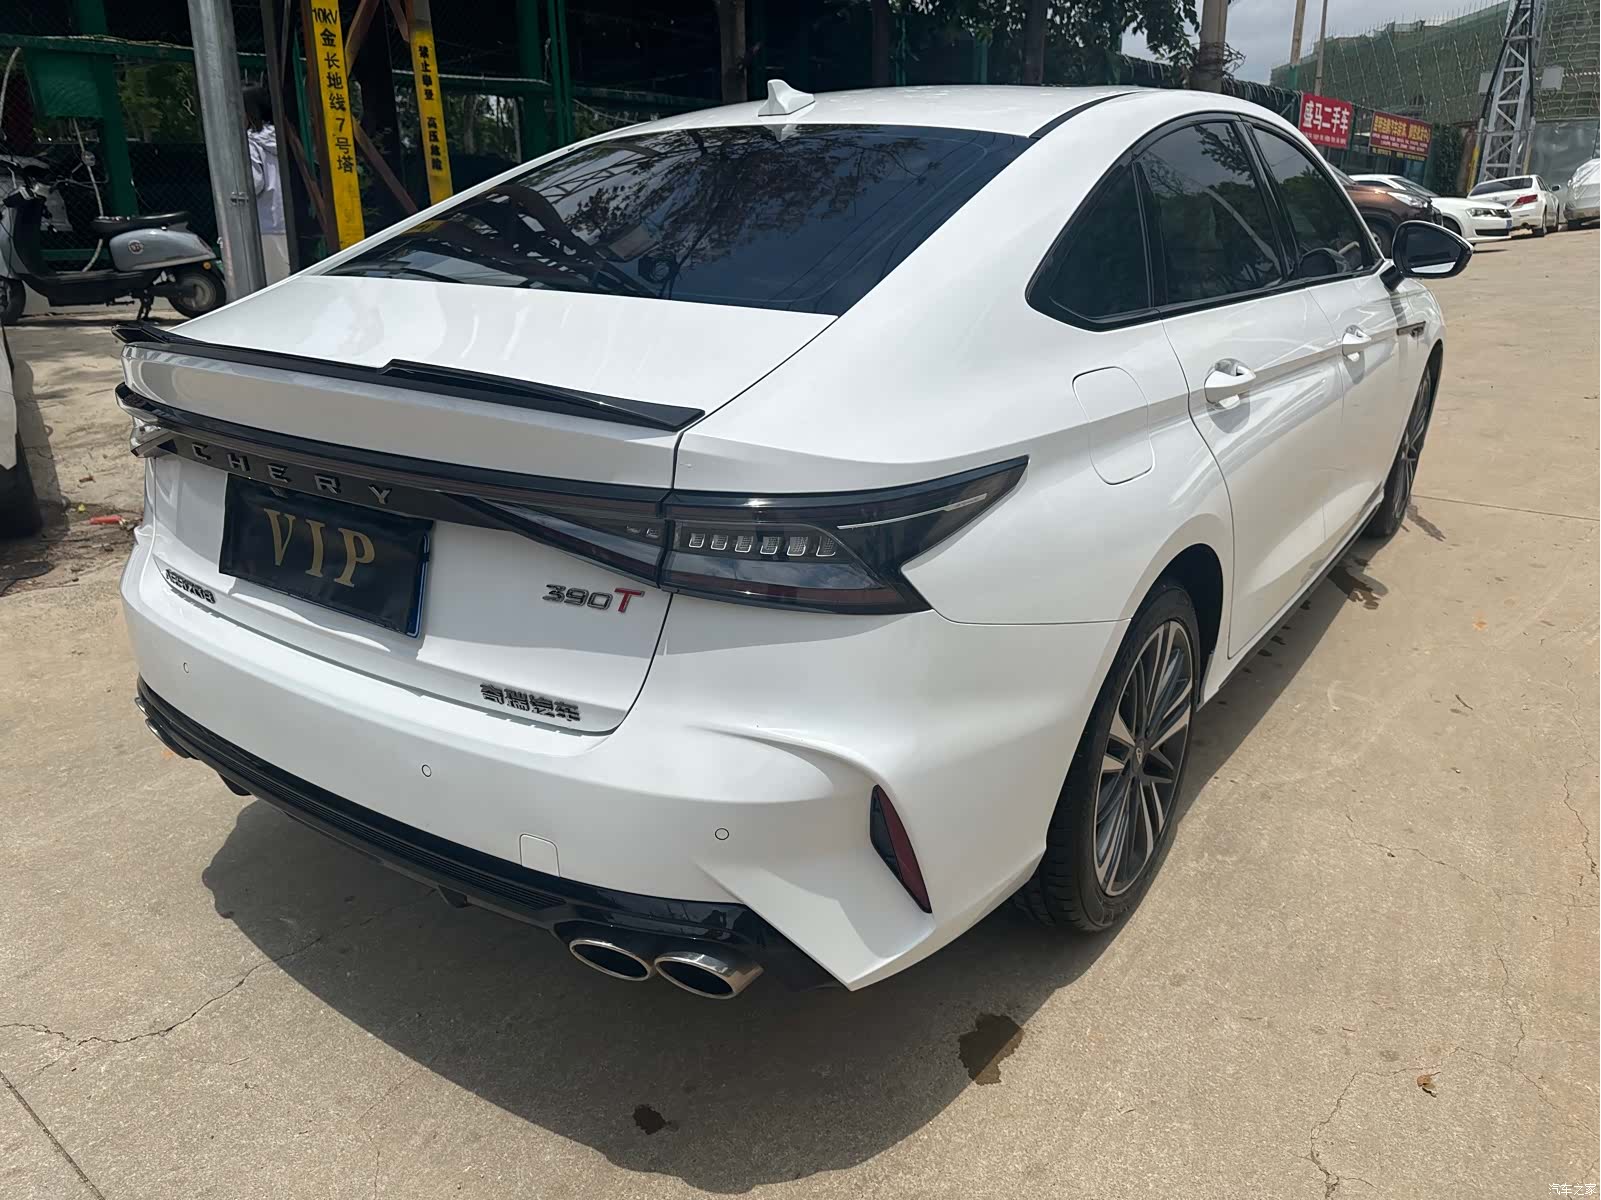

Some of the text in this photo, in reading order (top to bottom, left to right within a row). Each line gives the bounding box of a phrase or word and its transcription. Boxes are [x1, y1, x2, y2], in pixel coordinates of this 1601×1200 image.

[1302, 100, 1350, 135] 盛马二手车
[192, 442, 393, 505] CHERY
[263, 508, 376, 588] VIP
[542, 584, 646, 614] 390T
[480, 682, 581, 722] 奇瑞汽车
